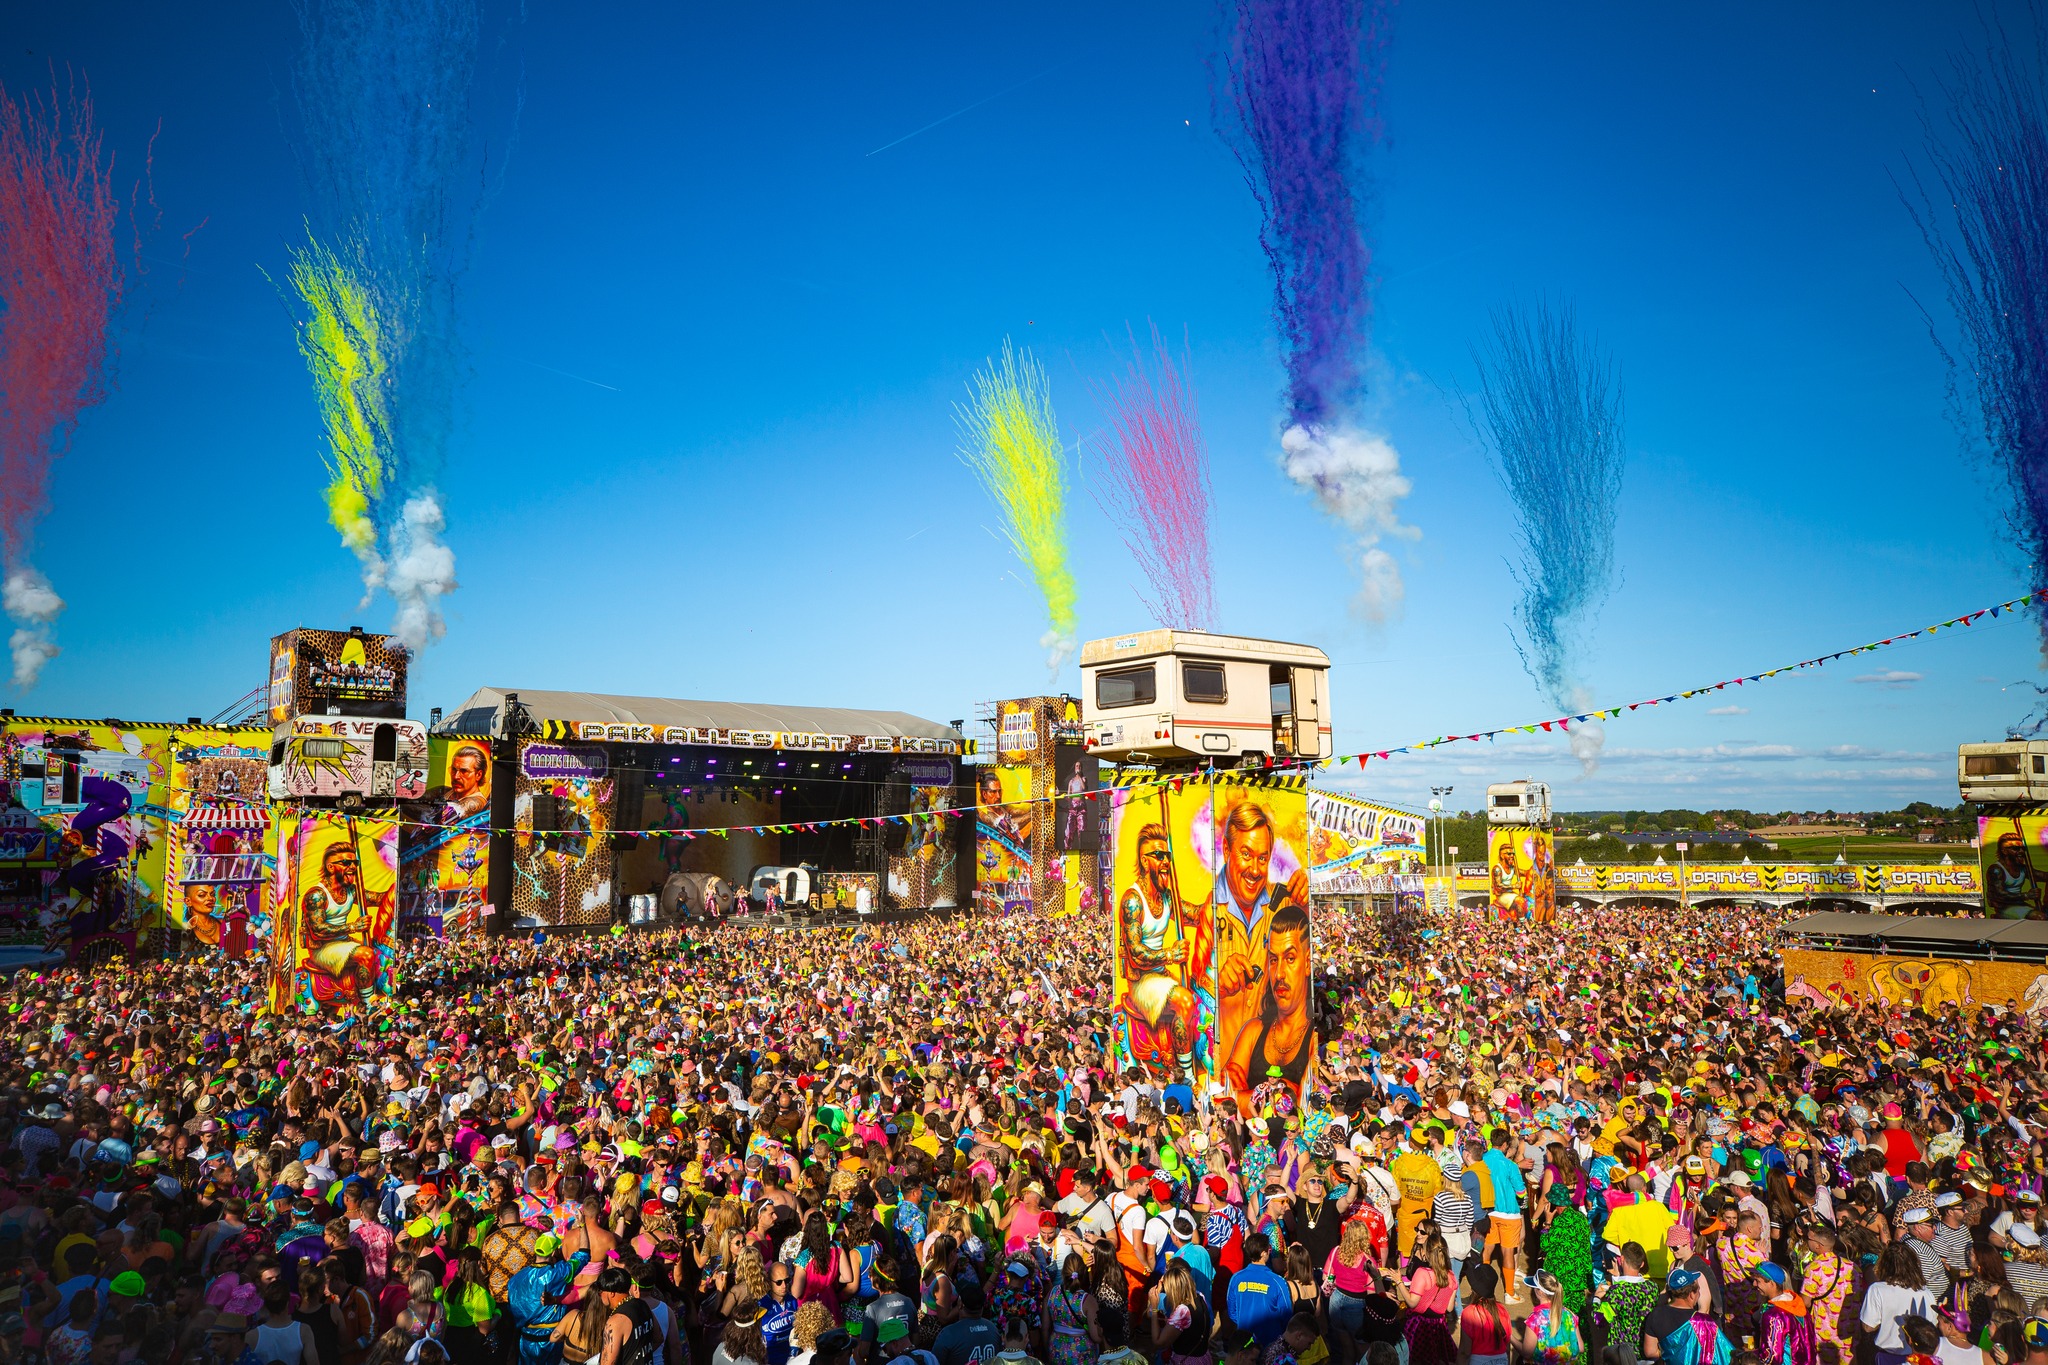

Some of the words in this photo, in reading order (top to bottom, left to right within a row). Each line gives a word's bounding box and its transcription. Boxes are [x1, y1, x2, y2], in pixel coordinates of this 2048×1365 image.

[329, 720, 347, 735] TE
[582, 724, 652, 741] PAK
[666, 728, 773, 747] ALLES
[783, 734, 849, 750] WAT
[859, 739, 892, 752] JE
[1323, 801, 1377, 839] KITSCH
[1613, 872, 1674, 884] DRINKS
[1692, 871, 1758, 884] DRINKS
[1784, 872, 1857, 885] DRINKS
[1891, 872, 1972, 885] DRINKS
[968, 1343, 995, 1365] 40
